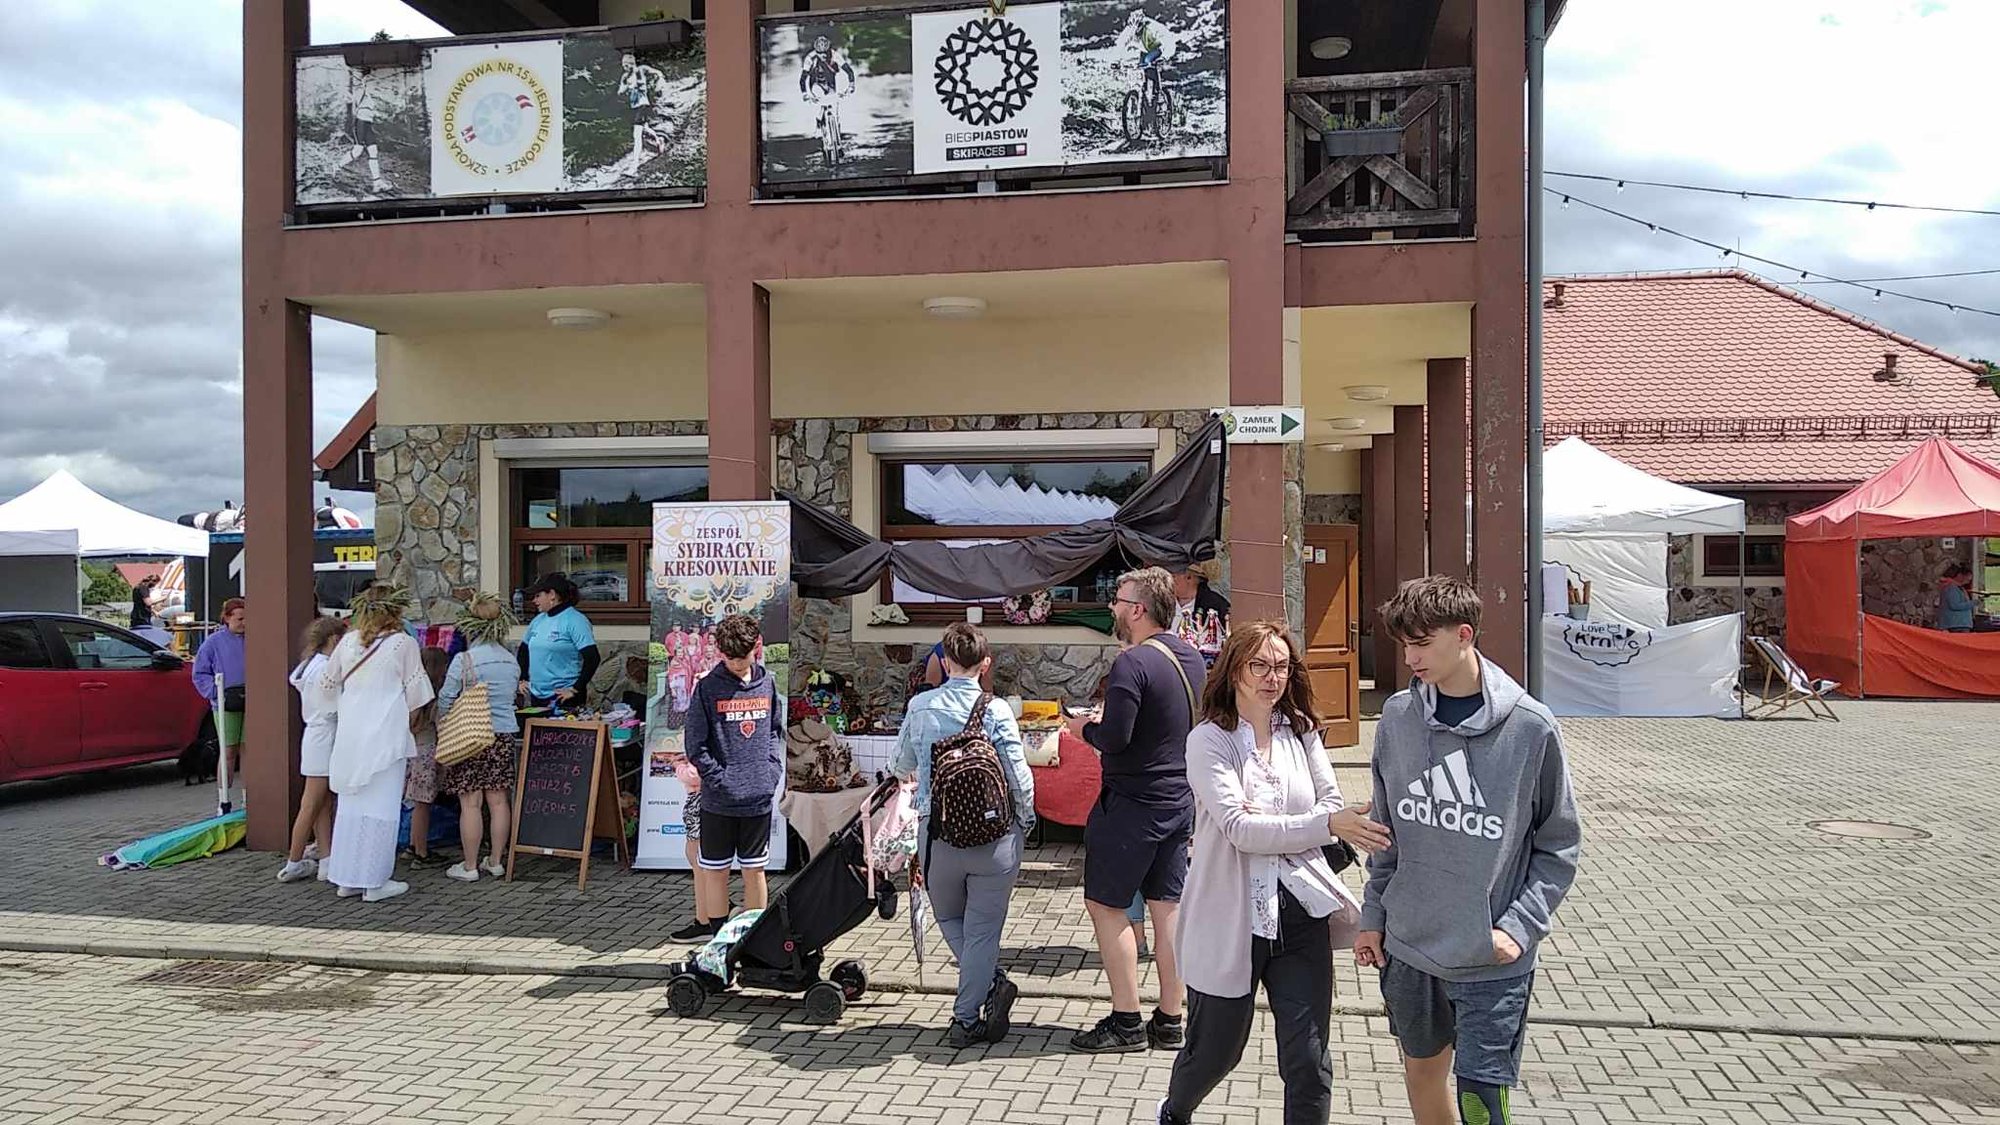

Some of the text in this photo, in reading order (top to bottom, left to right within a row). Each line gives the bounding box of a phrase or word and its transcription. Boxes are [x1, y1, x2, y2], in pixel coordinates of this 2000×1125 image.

[497, 61, 514, 73] NR
[516, 67, 530, 80] 15
[444, 63, 493, 140] PODSTAWOWA
[534, 88, 551, 143] JELENIEJ
[945, 128, 1028, 143] BIEGPIASTÓW
[450, 140, 488, 175] SZKOŁA
[952, 146, 1006, 159] SKIRACES
[1242, 416, 1274, 424] ZAMEK
[1238, 426, 1278, 434] CHOJNIK
[696, 524, 742, 539] ZESPÓŁ
[677, 542, 764, 558] SYBIRACY i
[663, 560, 777, 577] KRESOWIANIE
[725, 710, 767, 721] BEARS
[1397, 796, 1503, 840] adidas
